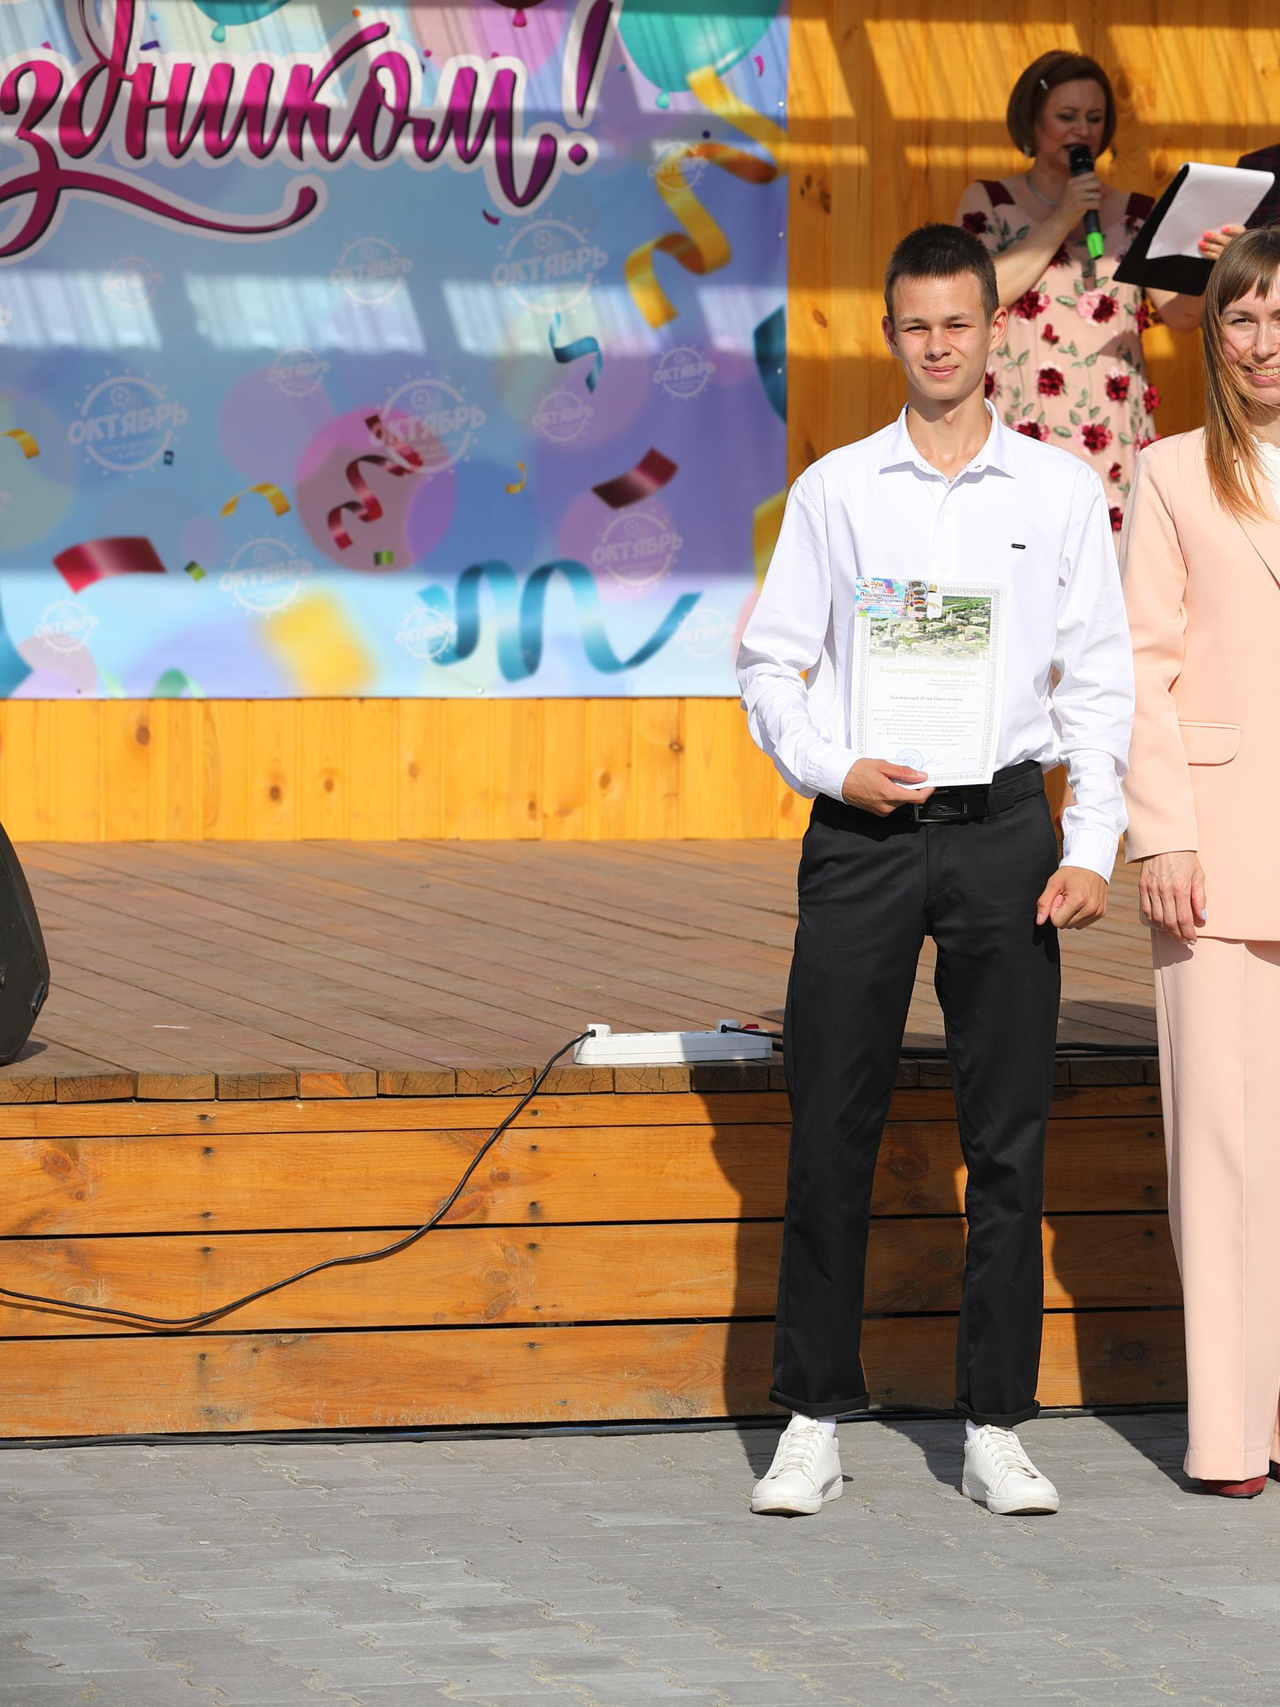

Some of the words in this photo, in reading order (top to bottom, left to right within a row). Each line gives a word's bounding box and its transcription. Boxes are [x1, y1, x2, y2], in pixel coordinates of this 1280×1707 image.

[330, 256, 414, 286] ОКТЯБРЬ
[491, 245, 609, 288] ОКТЯБРЬ
[653, 361, 716, 384] ОКТЯБРЬ
[67, 402, 189, 445] ОКТЯБРЬ
[531, 404, 595, 427] ОКТЯБРЬ
[592, 532, 683, 565] ОКТЯБРЬ
[220, 558, 313, 593] ОКТЯБРЬ
